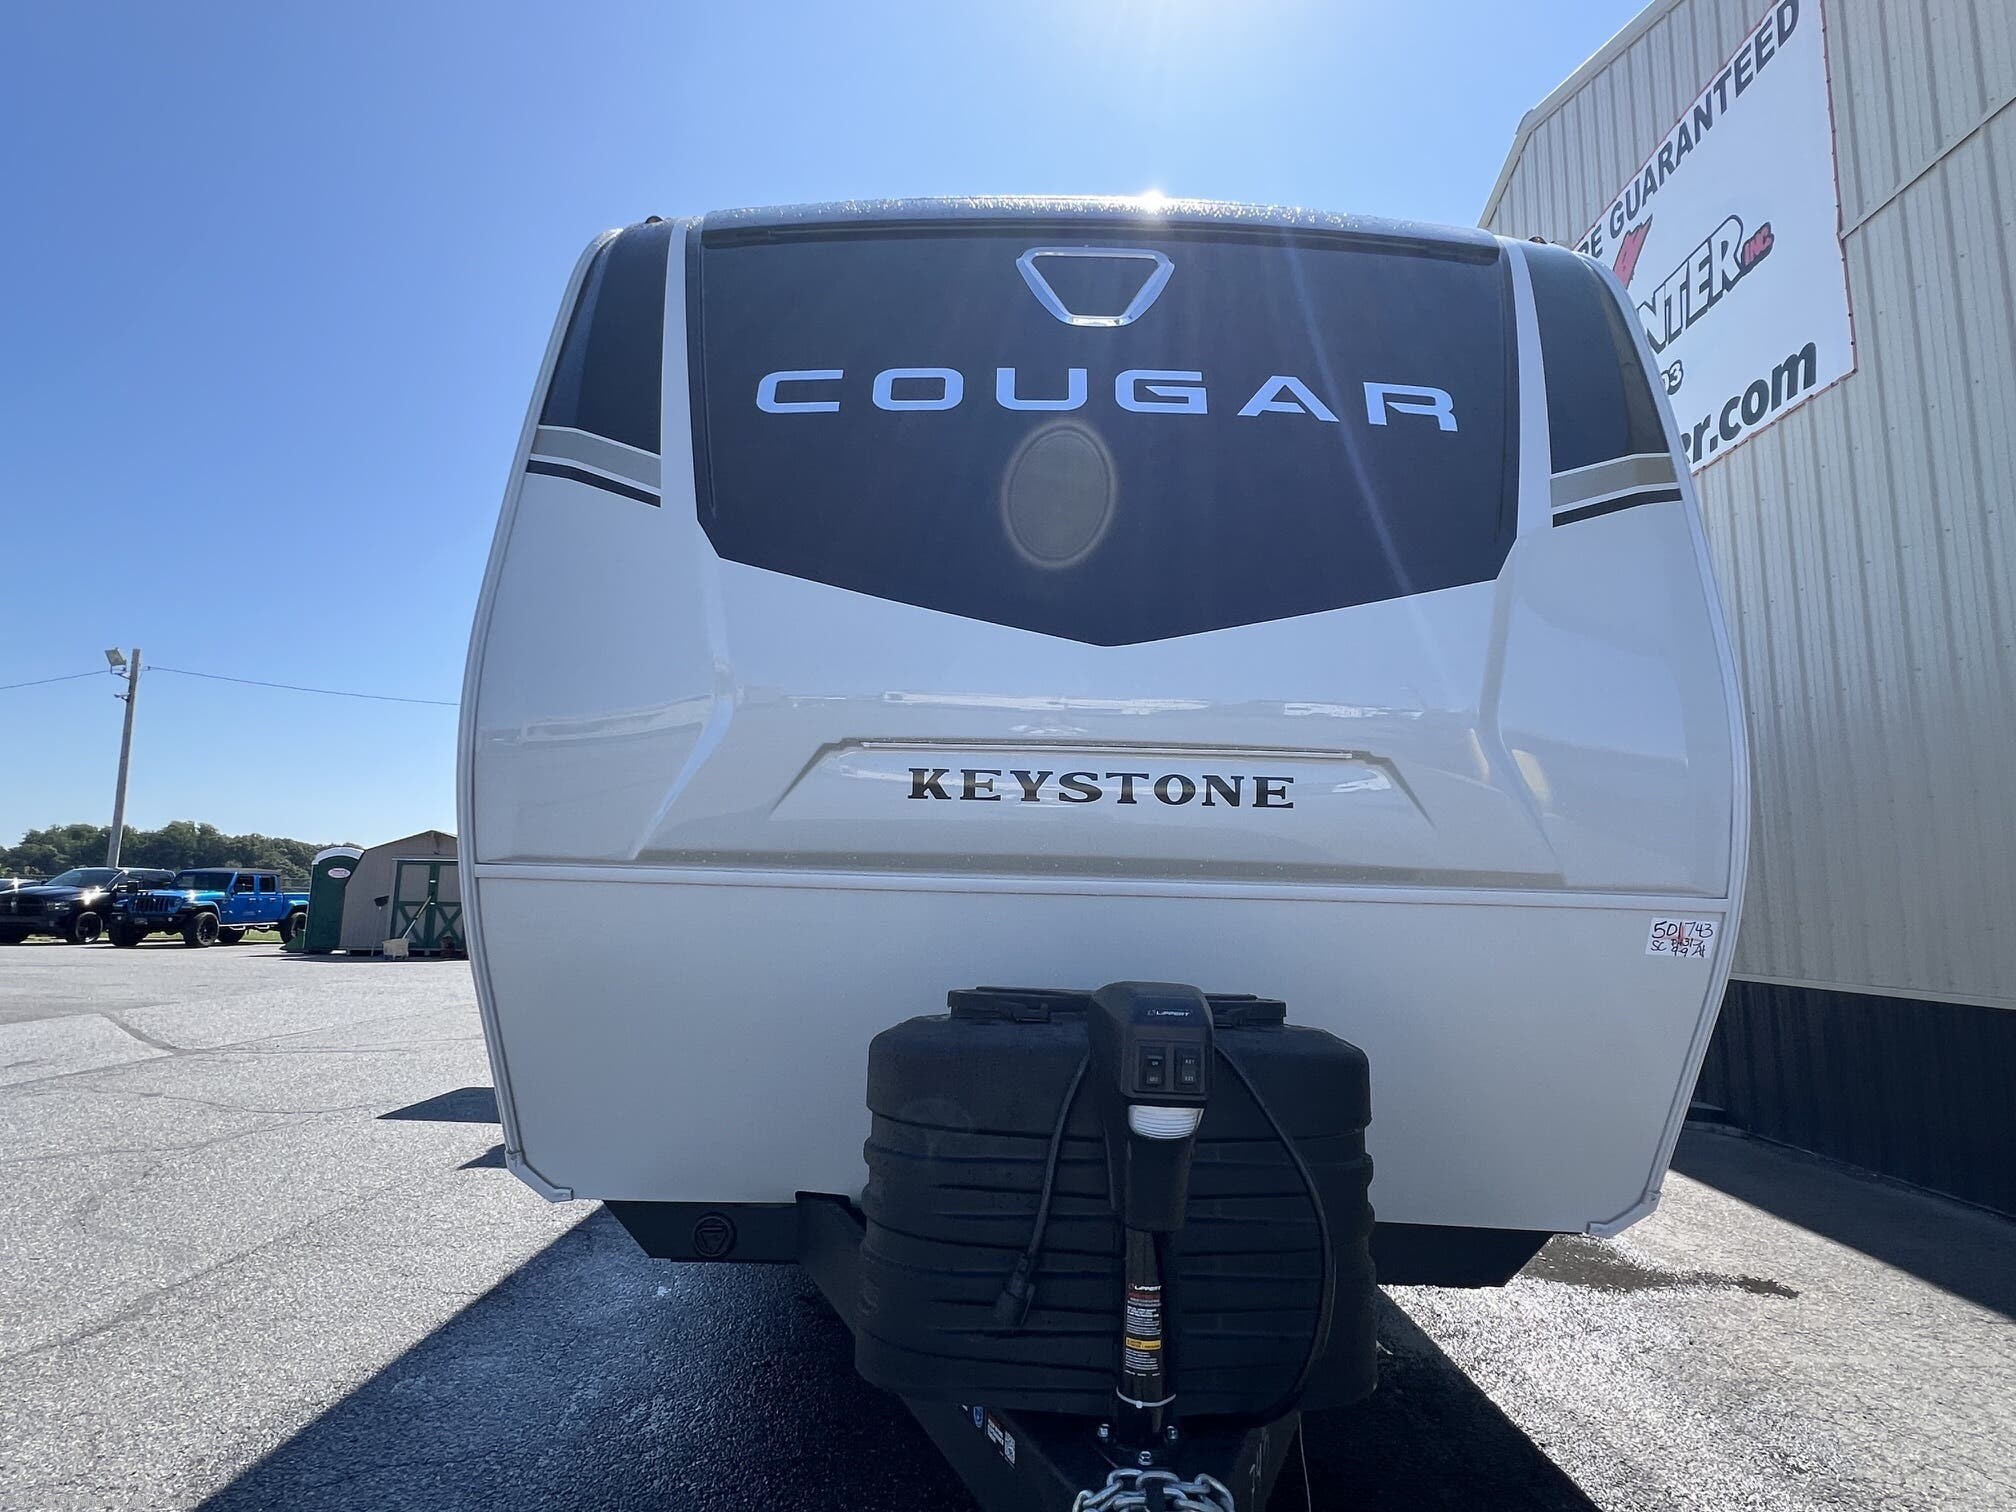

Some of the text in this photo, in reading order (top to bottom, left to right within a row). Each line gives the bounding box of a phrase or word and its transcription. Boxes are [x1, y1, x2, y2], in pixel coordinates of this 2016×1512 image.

[1609, 0, 1800, 239] GUARANTEED
[756, 367, 1459, 432] COUGAR
[907, 767, 1295, 808] KEYSTONE
